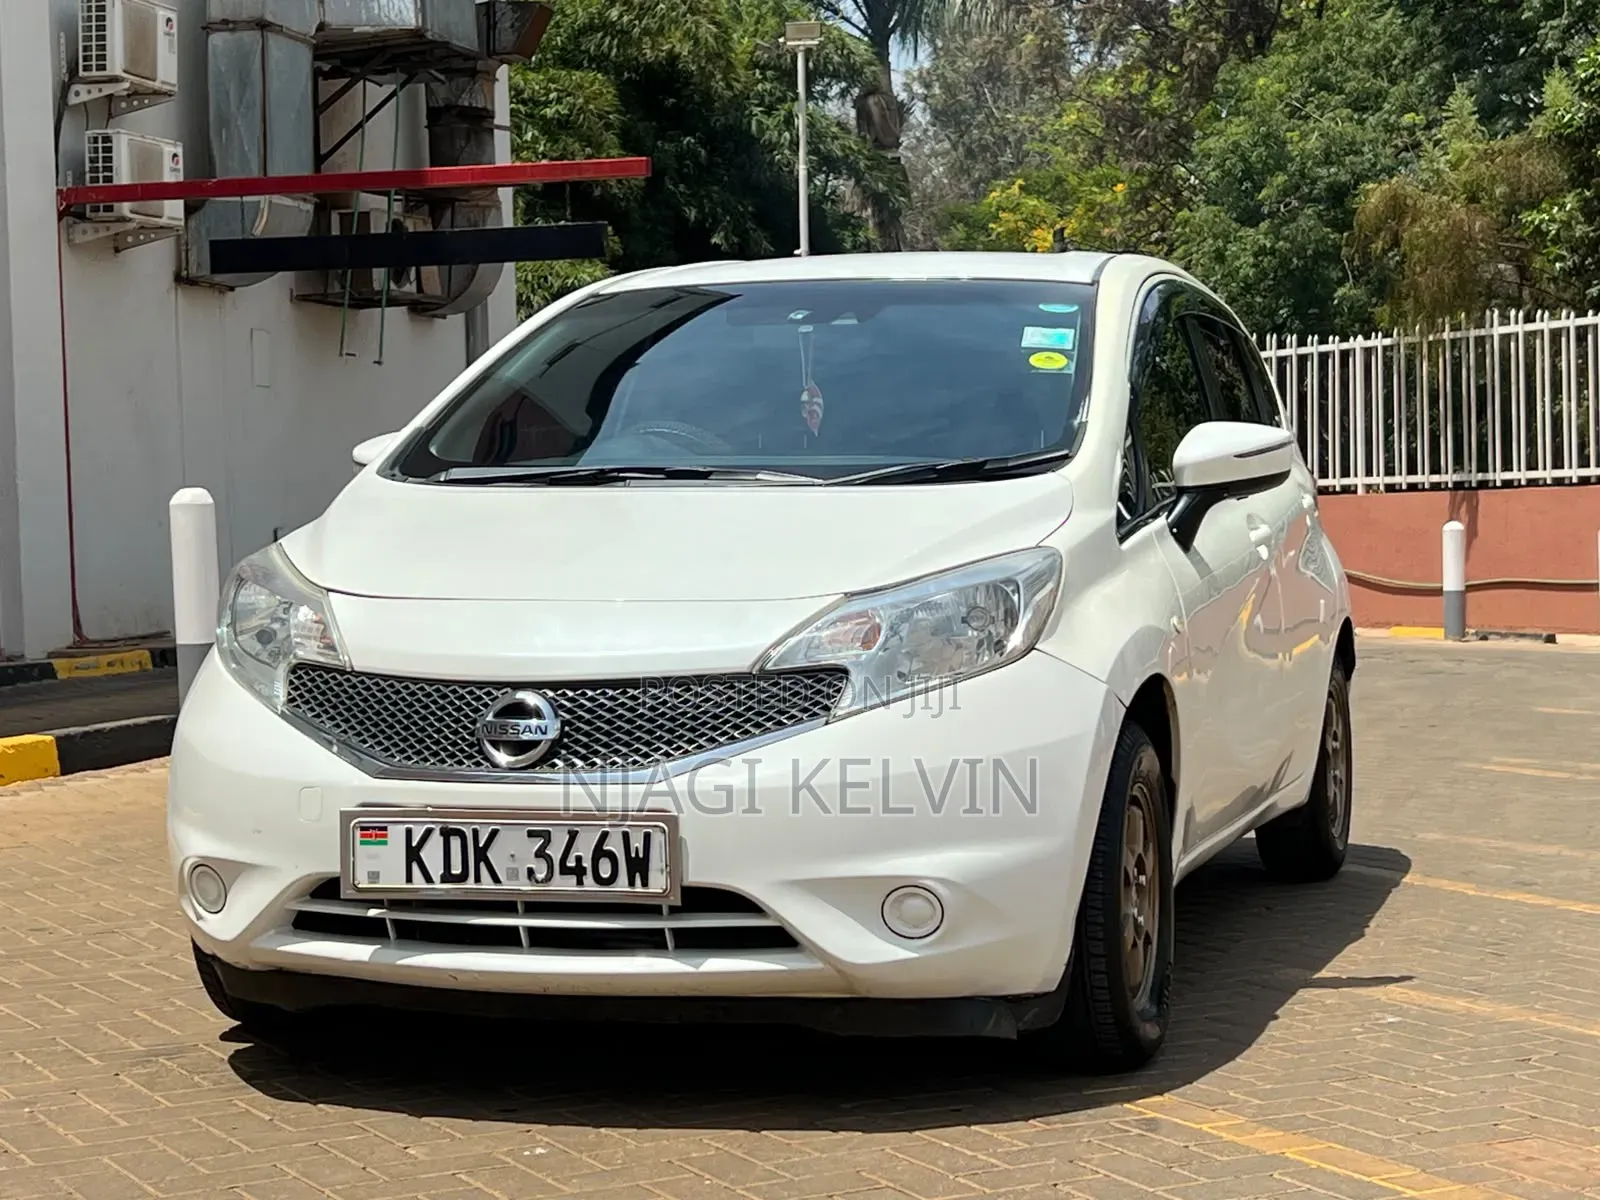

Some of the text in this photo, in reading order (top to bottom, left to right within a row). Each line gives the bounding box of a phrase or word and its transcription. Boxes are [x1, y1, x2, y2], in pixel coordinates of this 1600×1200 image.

[481, 724, 548, 736] NISSAN
[404, 825, 652, 887] KDK 346W
